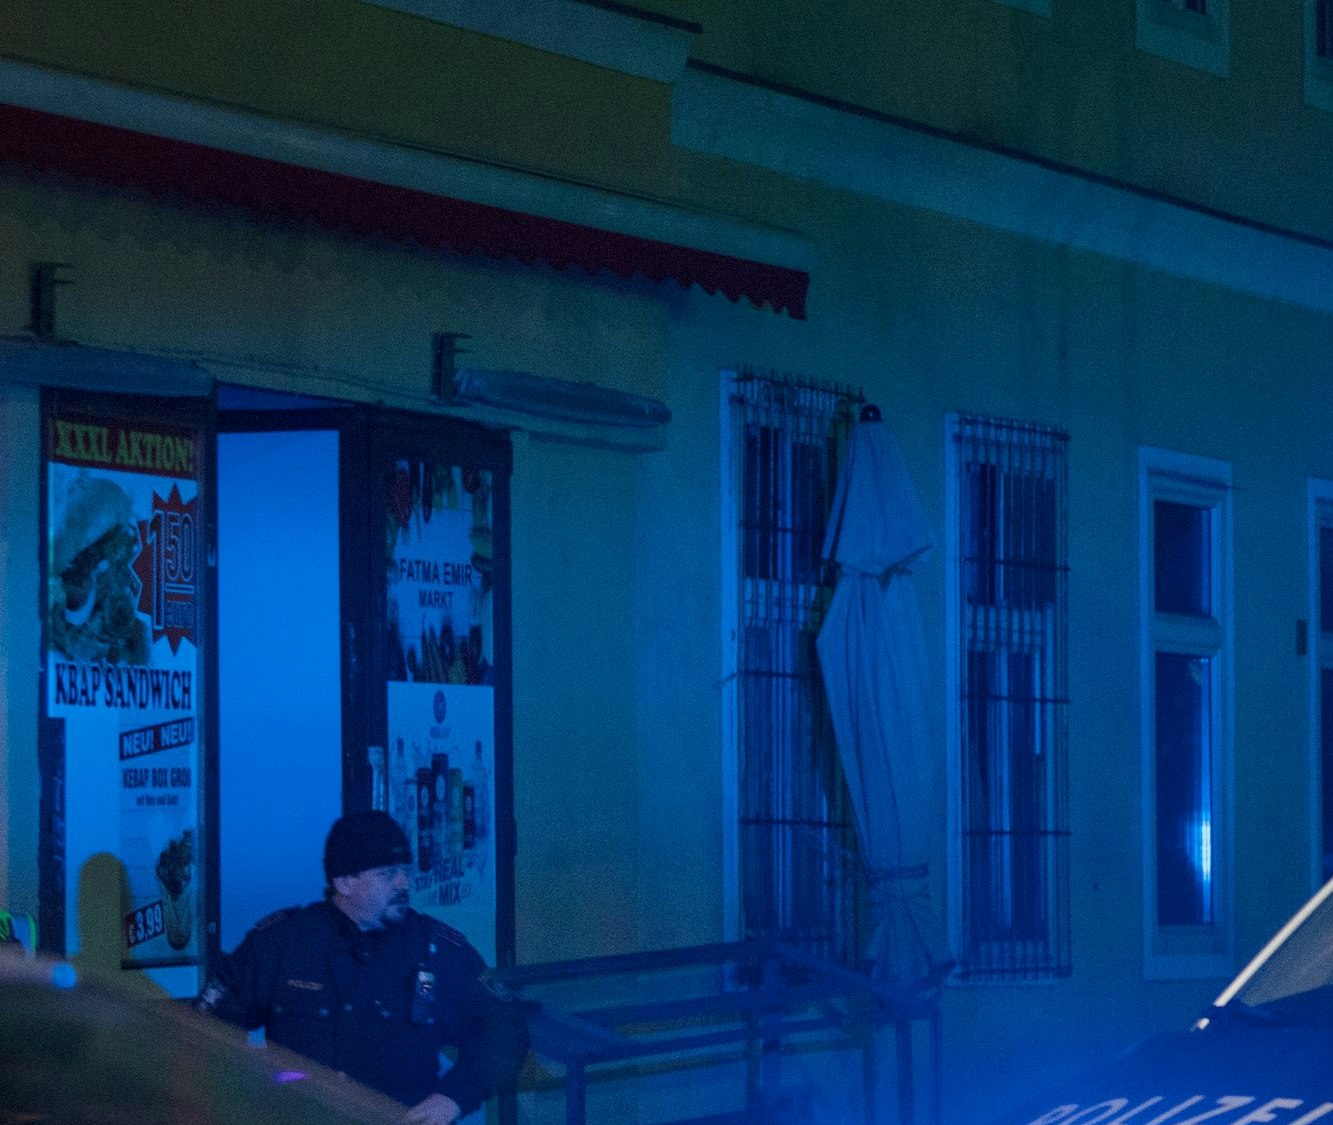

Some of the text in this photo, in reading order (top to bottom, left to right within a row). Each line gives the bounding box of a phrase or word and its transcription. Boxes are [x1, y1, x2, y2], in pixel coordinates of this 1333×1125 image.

[55, 420, 193, 473] XXXL AKTION!
[400, 558, 473, 586] FATMA EMIR
[419, 589, 453, 610] MARKT
[55, 662, 192, 710] KBAP SANDWICH
[123, 729, 154, 757] NEU!
